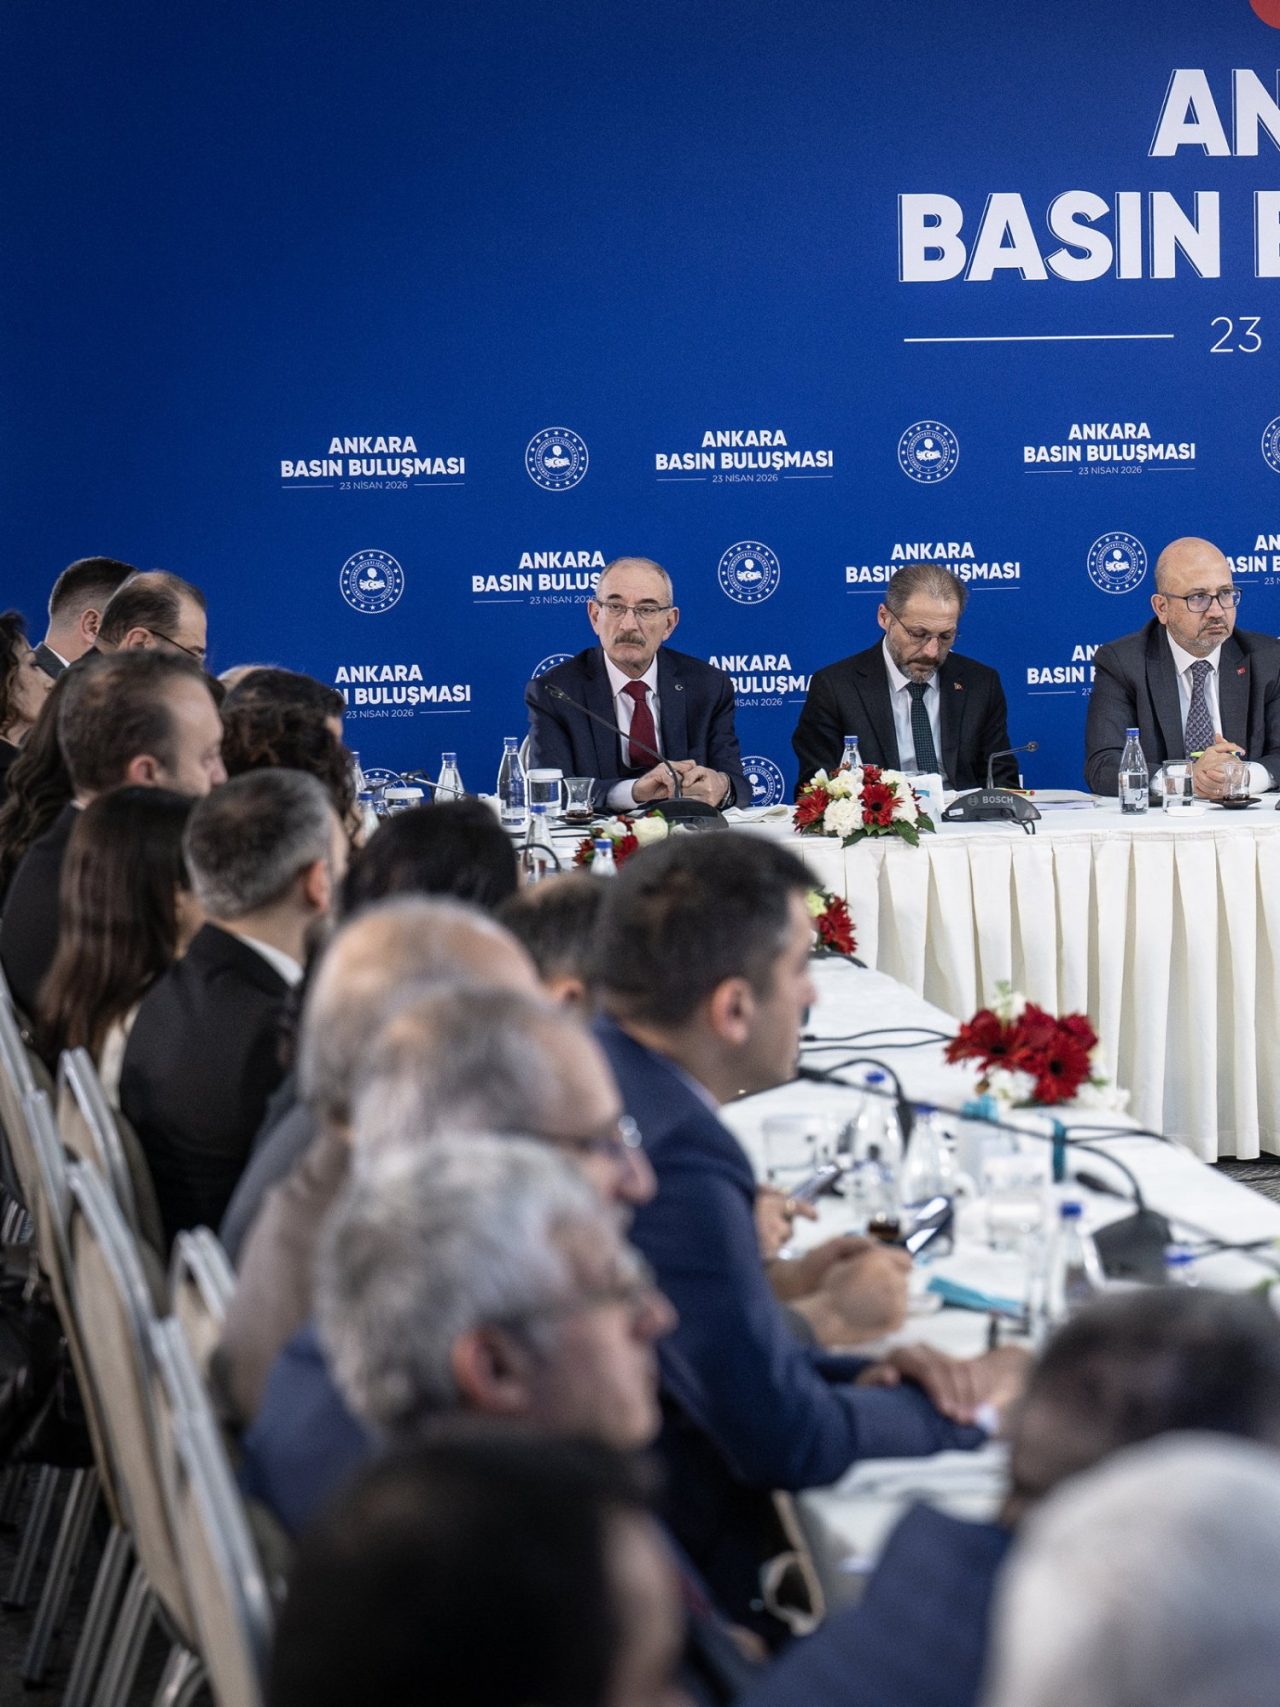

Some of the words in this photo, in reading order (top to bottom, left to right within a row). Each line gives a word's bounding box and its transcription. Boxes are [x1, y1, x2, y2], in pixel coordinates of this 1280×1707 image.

[898, 191, 1220, 282] BASIN
[1210, 317, 1261, 352] 23
[702, 430, 787, 447] ANKARA
[1069, 423, 1151, 440] ANKARA
[329, 436, 417, 454] ANKARA
[1024, 446, 1081, 462] BASIN
[1087, 443, 1195, 462] BULUŞMASI
[281, 460, 342, 477] BASIN
[349, 457, 465, 477] BULUŞMASI
[656, 453, 715, 470] BASIN
[721, 451, 833, 470] BULUŞMASI
[713, 475, 723, 483] 23
[726, 474, 753, 482] NİSAN
[756, 474, 778, 482] 2026
[1079, 467, 1088, 475] 23
[1091, 466, 1118, 474] NİSAN
[1121, 466, 1142, 474] 2026
[340, 482, 351, 490] 23
[354, 481, 382, 489] NİSAN
[386, 481, 408, 489] 2026
[891, 542, 975, 560] ANKARA
[519, 551, 606, 569] ANKARA
[1226, 556, 1266, 573] ASIN
[472, 574, 532, 592] BASIN
[1264, 577, 1274, 585] 23
[530, 596, 540, 604] 23
[543, 596, 572, 604] NİSAN
[709, 654, 791, 672] ANKARA
[335, 665, 423, 683] ANKARA
[1028, 667, 1084, 684] BASIN
[355, 685, 470, 705] BULUŞMASI
[761, 698, 782, 706] 2026
[360, 710, 388, 718] NİSAN
[392, 709, 414, 717] 2026
[982, 796, 1014, 804] BOSCH
